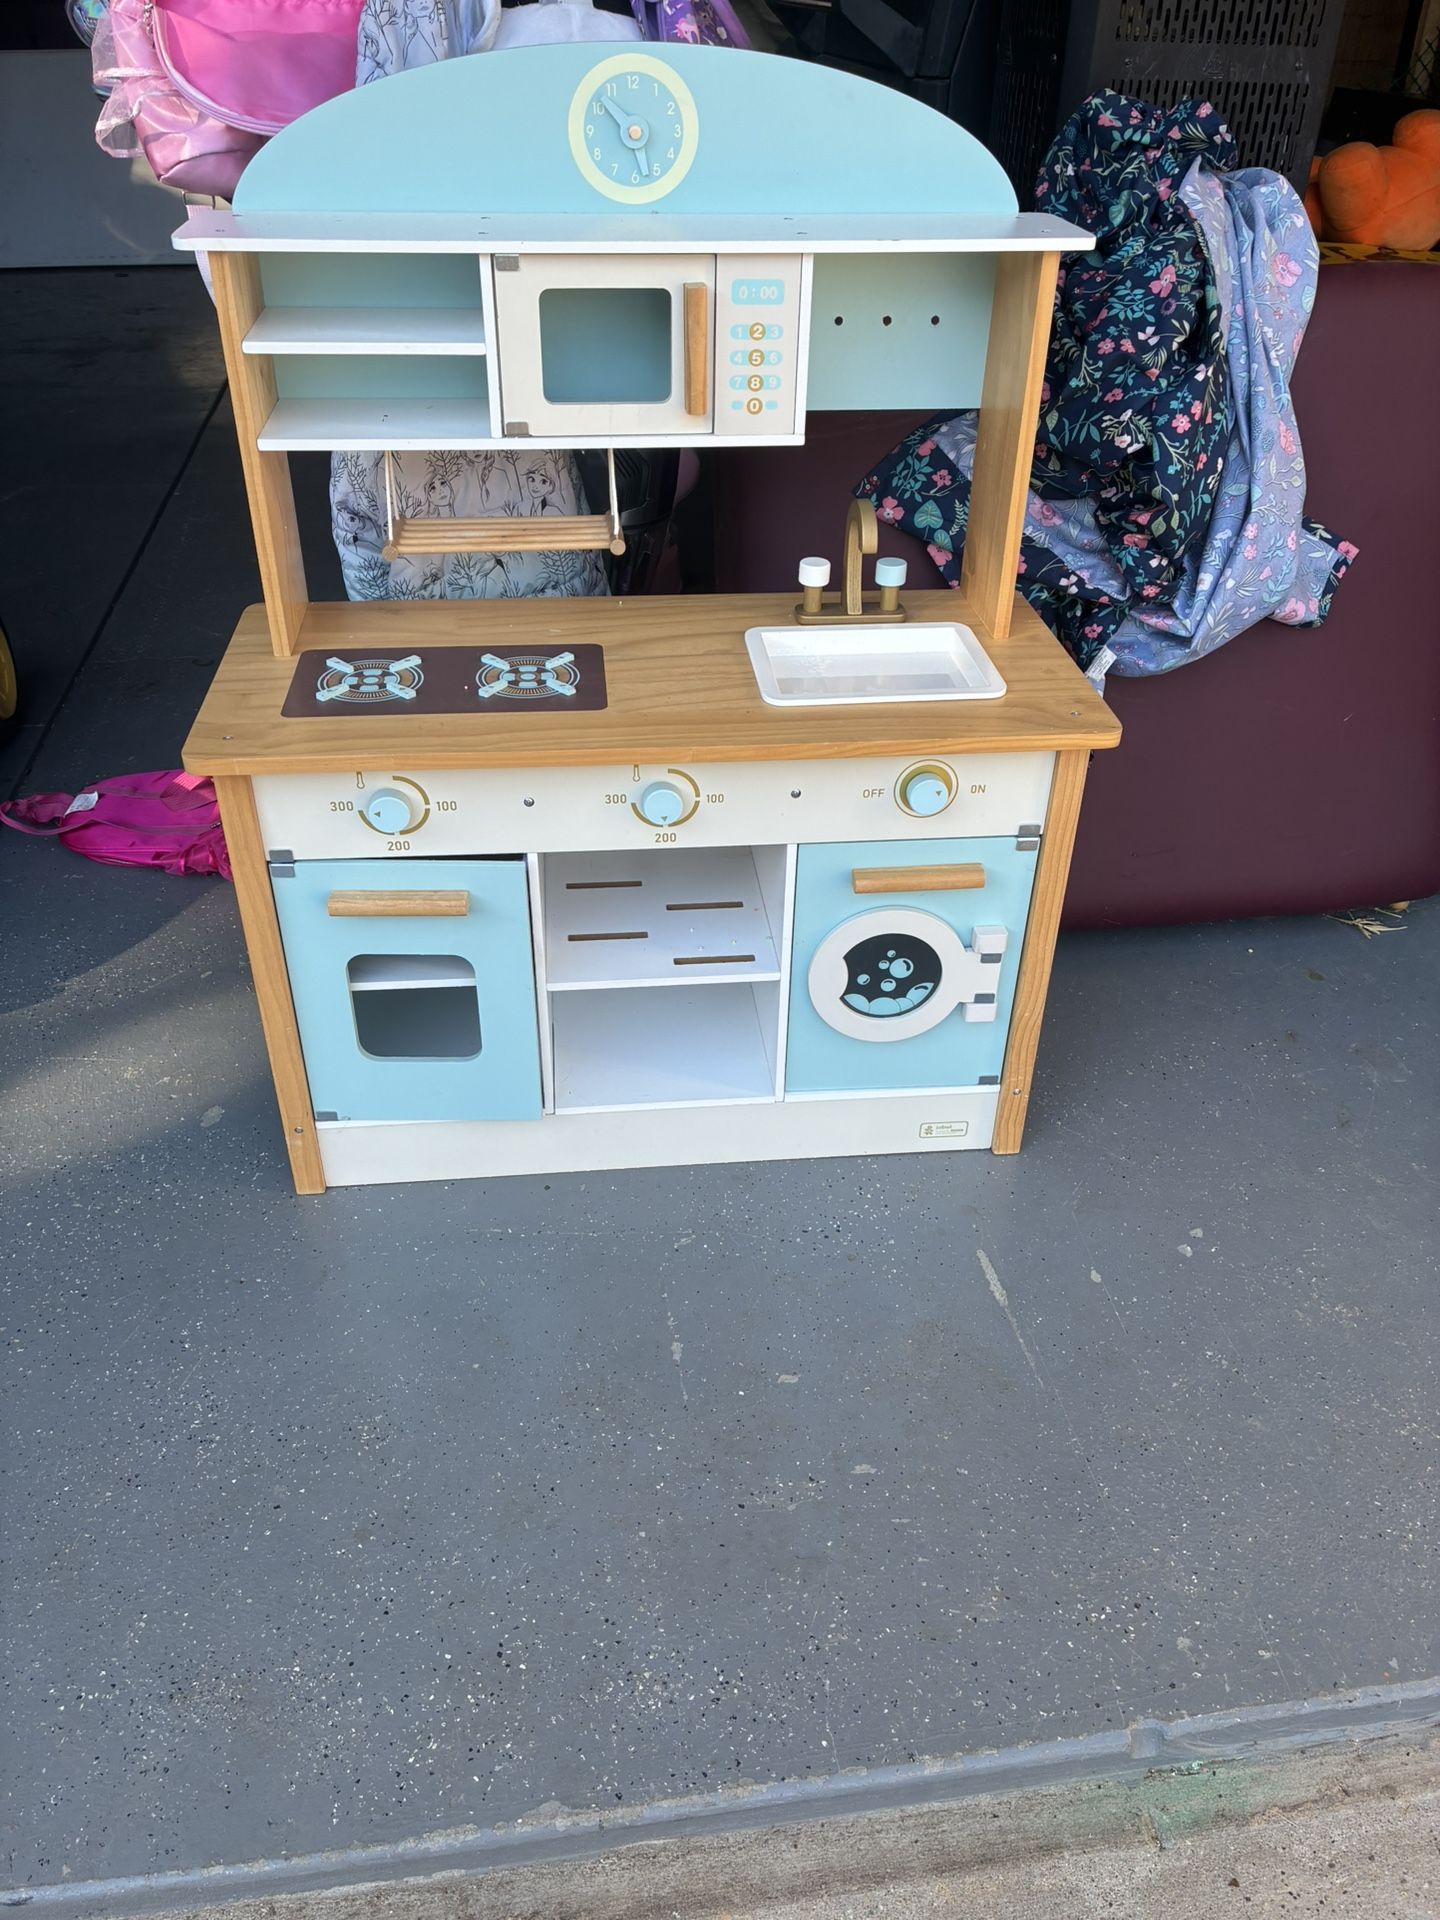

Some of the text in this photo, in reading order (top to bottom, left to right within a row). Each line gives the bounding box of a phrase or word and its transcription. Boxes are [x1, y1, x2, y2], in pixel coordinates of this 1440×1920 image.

[626, 75, 640, 89] 12
[606, 84, 617, 96] 11
[654, 84, 658, 96] 1
[592, 102, 605, 115] 10
[667, 102, 675, 115] 2
[586, 125, 594, 138] 9
[674, 125, 681, 137] 3
[594, 148, 601, 160] 8
[667, 147, 674, 158] 4
[612, 164, 618, 176] 7
[653, 164, 660, 176] 5
[632, 171, 639, 183] 6
[739, 286, 778, 299] 0:00
[753, 326, 762, 338] 2
[771, 327, 778, 337] 3
[734, 352, 777, 364] 4 5 6
[735, 377, 777, 389] 7 8 9
[750, 400, 759, 412] 0
[862, 789, 885, 798] OFF
[970, 785, 986, 793] ON
[605, 794, 627, 804] 300
[706, 794, 724, 803] 100
[330, 801, 354, 812] 300
[436, 801, 457, 812] 100
[655, 833, 676, 842] 200
[387, 841, 410, 851] 200
